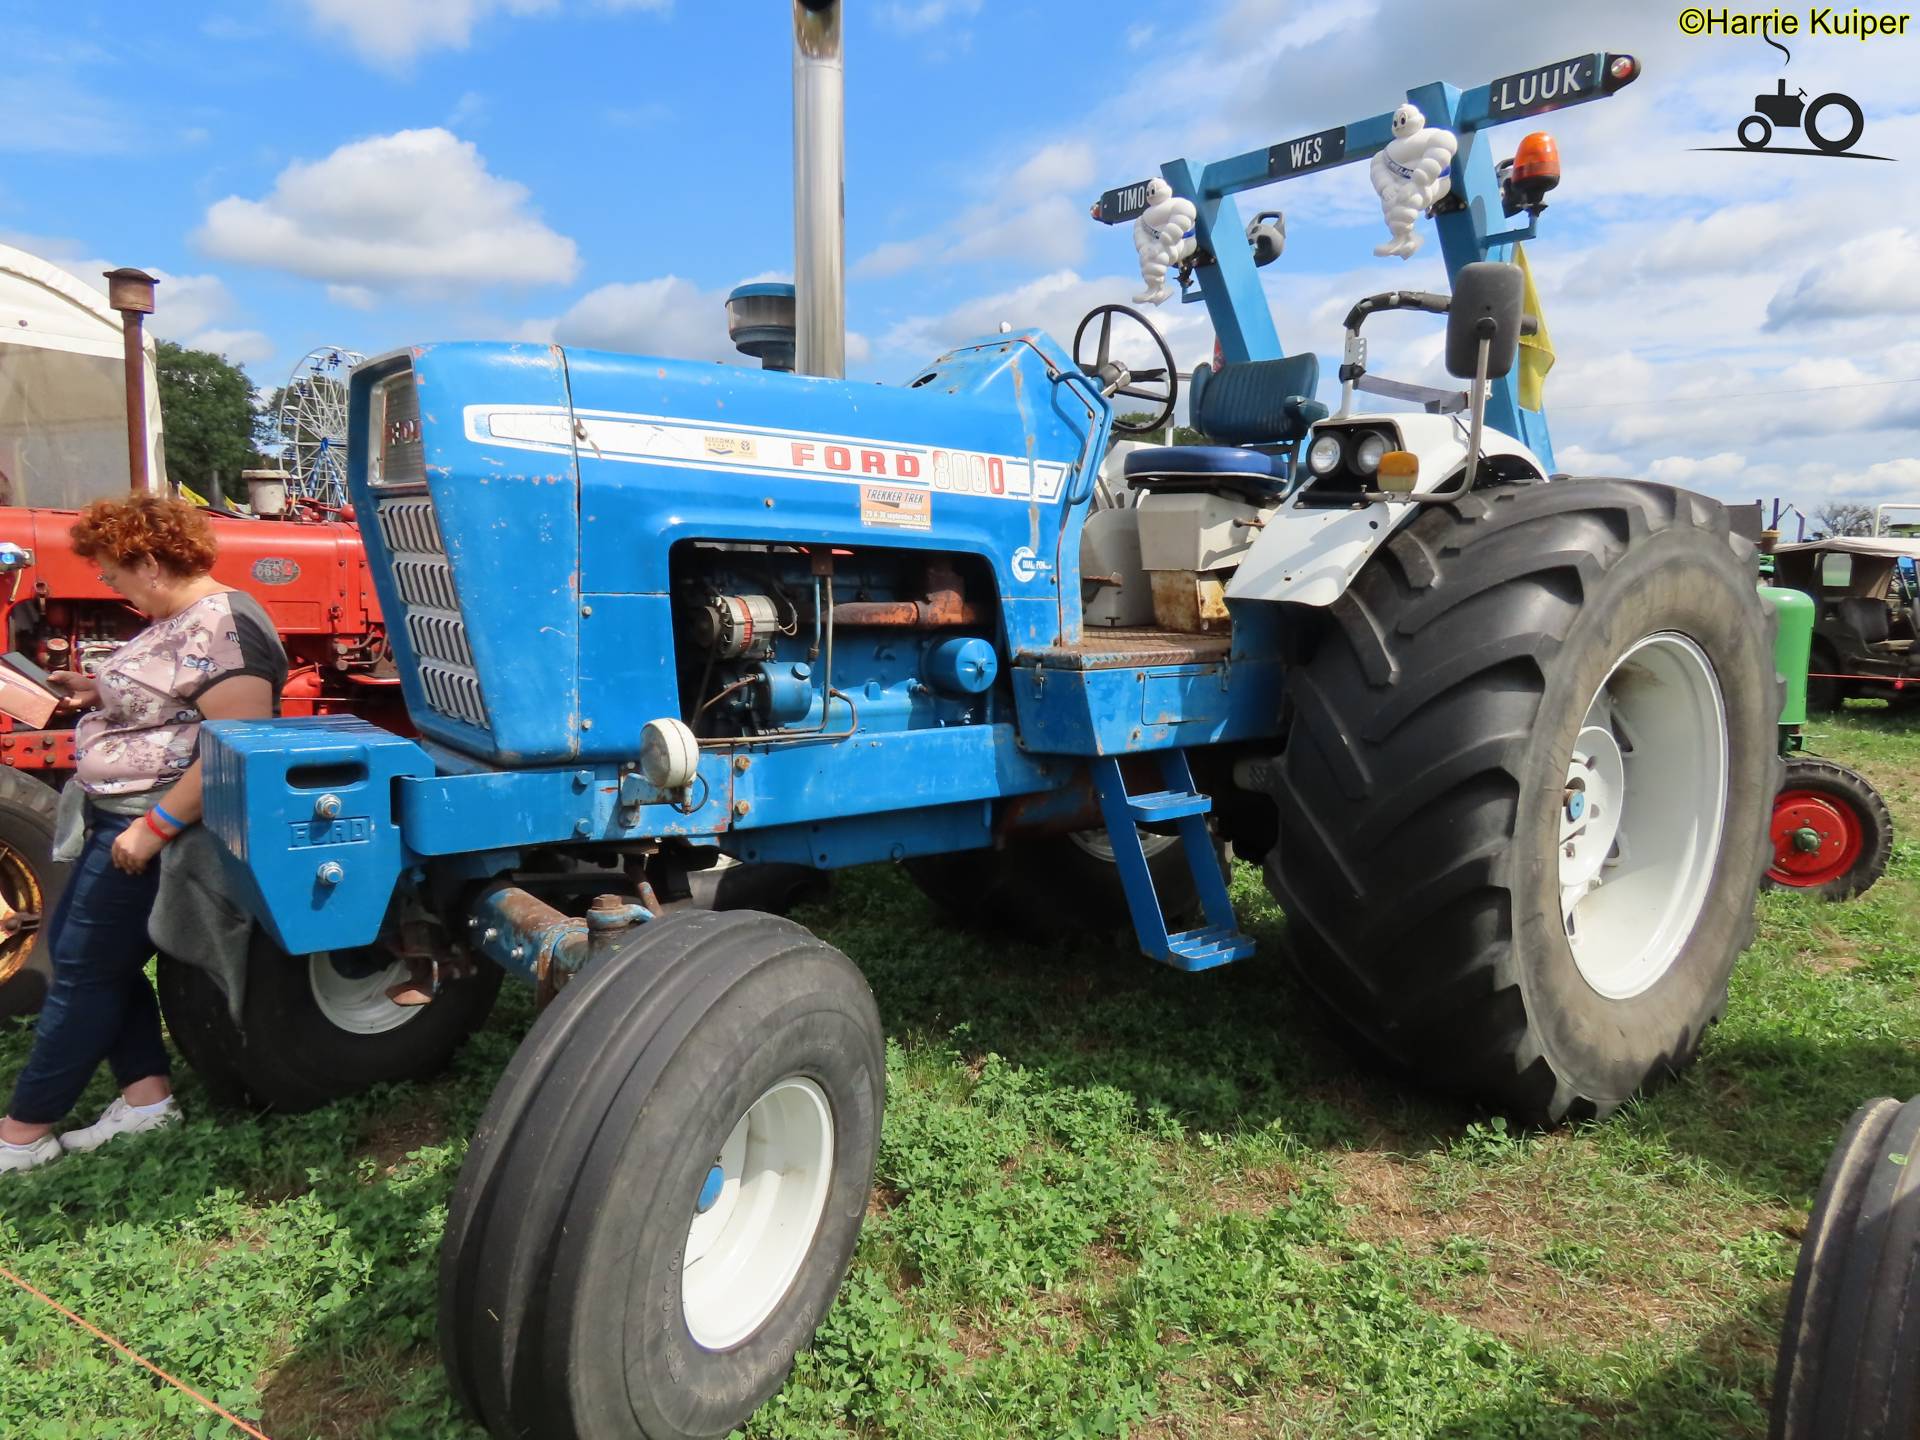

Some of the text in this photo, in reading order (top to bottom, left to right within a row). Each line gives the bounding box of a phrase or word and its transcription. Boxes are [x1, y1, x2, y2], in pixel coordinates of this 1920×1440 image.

[1500, 62, 1581, 111] LUUK
[1290, 136, 1322, 169] WES
[1117, 185, 1145, 214] TIMO
[790, 442, 1005, 496] FORD 8000
[866, 488, 924, 504] TREKKER TREK
[290, 818, 368, 847] FORD
